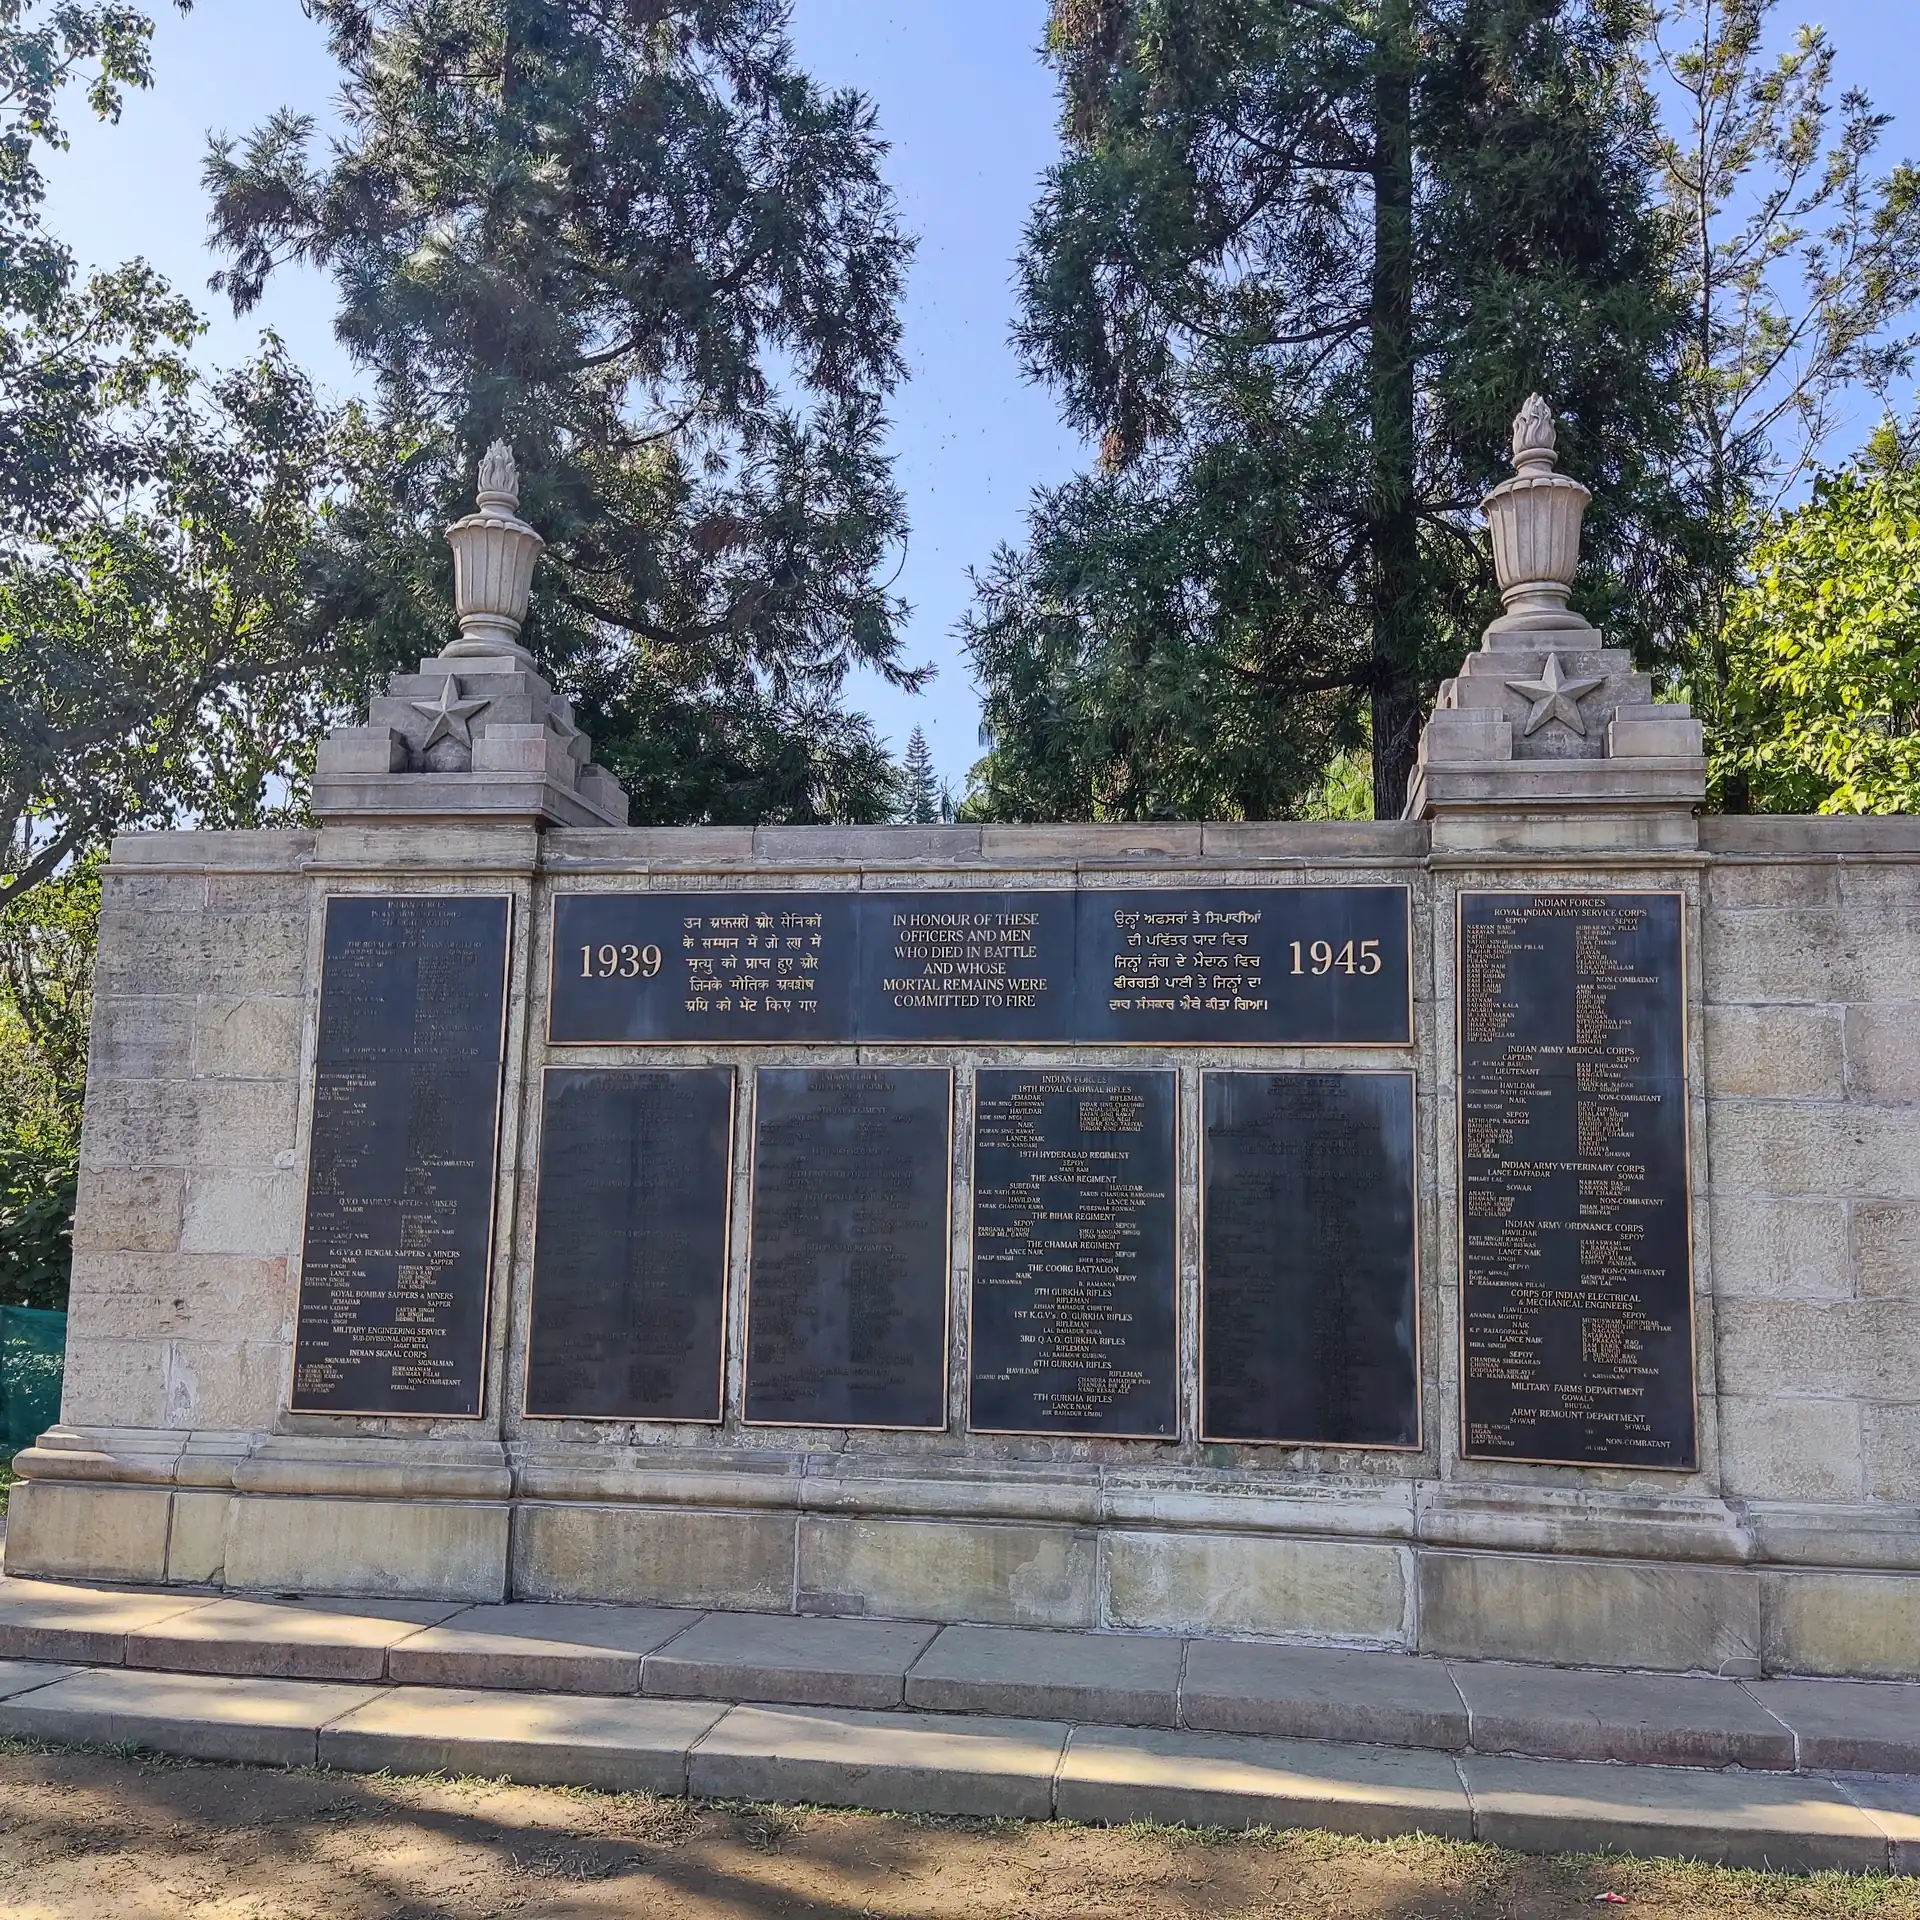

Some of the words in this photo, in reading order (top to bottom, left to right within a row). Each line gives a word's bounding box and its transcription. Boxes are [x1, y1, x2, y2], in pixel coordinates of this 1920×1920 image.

[893, 915, 906, 926] IN
[911, 914, 970, 925] HONOUR
[974, 914, 992, 925] OF
[996, 914, 1039, 925] THESE
[901, 930, 963, 942] OFFICERS
[967, 930, 996, 941] AND
[1000, 930, 1030, 941] MEN
[895, 947, 927, 958] WHO
[932, 947, 963, 958] DIED
[967, 946, 980, 958] IN
[985, 946, 1036, 957] BATTLE
[1290, 940, 1381, 974] 1945
[581, 945, 661, 977] 1939
[924, 963, 953, 974] AND
[956, 963, 1006, 974] WHOSE
[883, 979, 940, 990] MORTAL
[944, 979, 1004, 990] REMAINS
[1008, 979, 1047, 990] WERE
[894, 995, 979, 1006] COMMITTED
[983, 995, 1002, 1006] TO
[1007, 995, 1035, 1006] FIRE
[1560, 1163, 1614, 1171] VETERINARY
[1506, 1220, 1534, 1228] INDIAN
[1565, 1223, 1612, 1231] ORDNANCE
[1615, 1224, 1643, 1232] CORPS
[1076, 1265, 1119, 1273] BATTALION
[1511, 1289, 1539, 1299] CORPS
[1542, 1291, 1553, 1299] OF
[1556, 1292, 1585, 1301] INDIAN
[1586, 1293, 1641, 1303] ELECTRICAL
[1526, 1297, 1583, 1309] MECHANICAL
[1585, 1300, 1633, 1310] ENGINEERS
[368, 1327, 415, 1336] ENGINEERING
[1051, 1360, 1084, 1368] GURKHA
[1086, 1361, 1111, 1369] RIFLES
[1613, 1367, 1658, 1375] CRAFTSMAN
[1512, 1383, 1550, 1391] MILITARY
[1554, 1384, 1582, 1392] FARMS
[1586, 1386, 1644, 1395] DEPARTMENT
[1051, 1394, 1083, 1402] GURKHA
[1087, 1395, 1112, 1403] RIFLES
[1540, 1410, 1583, 1418] REMOUNT
[1587, 1413, 1645, 1422] DEPARTMENT
[1605, 1439, 1671, 1448] NON-COMBATANT
